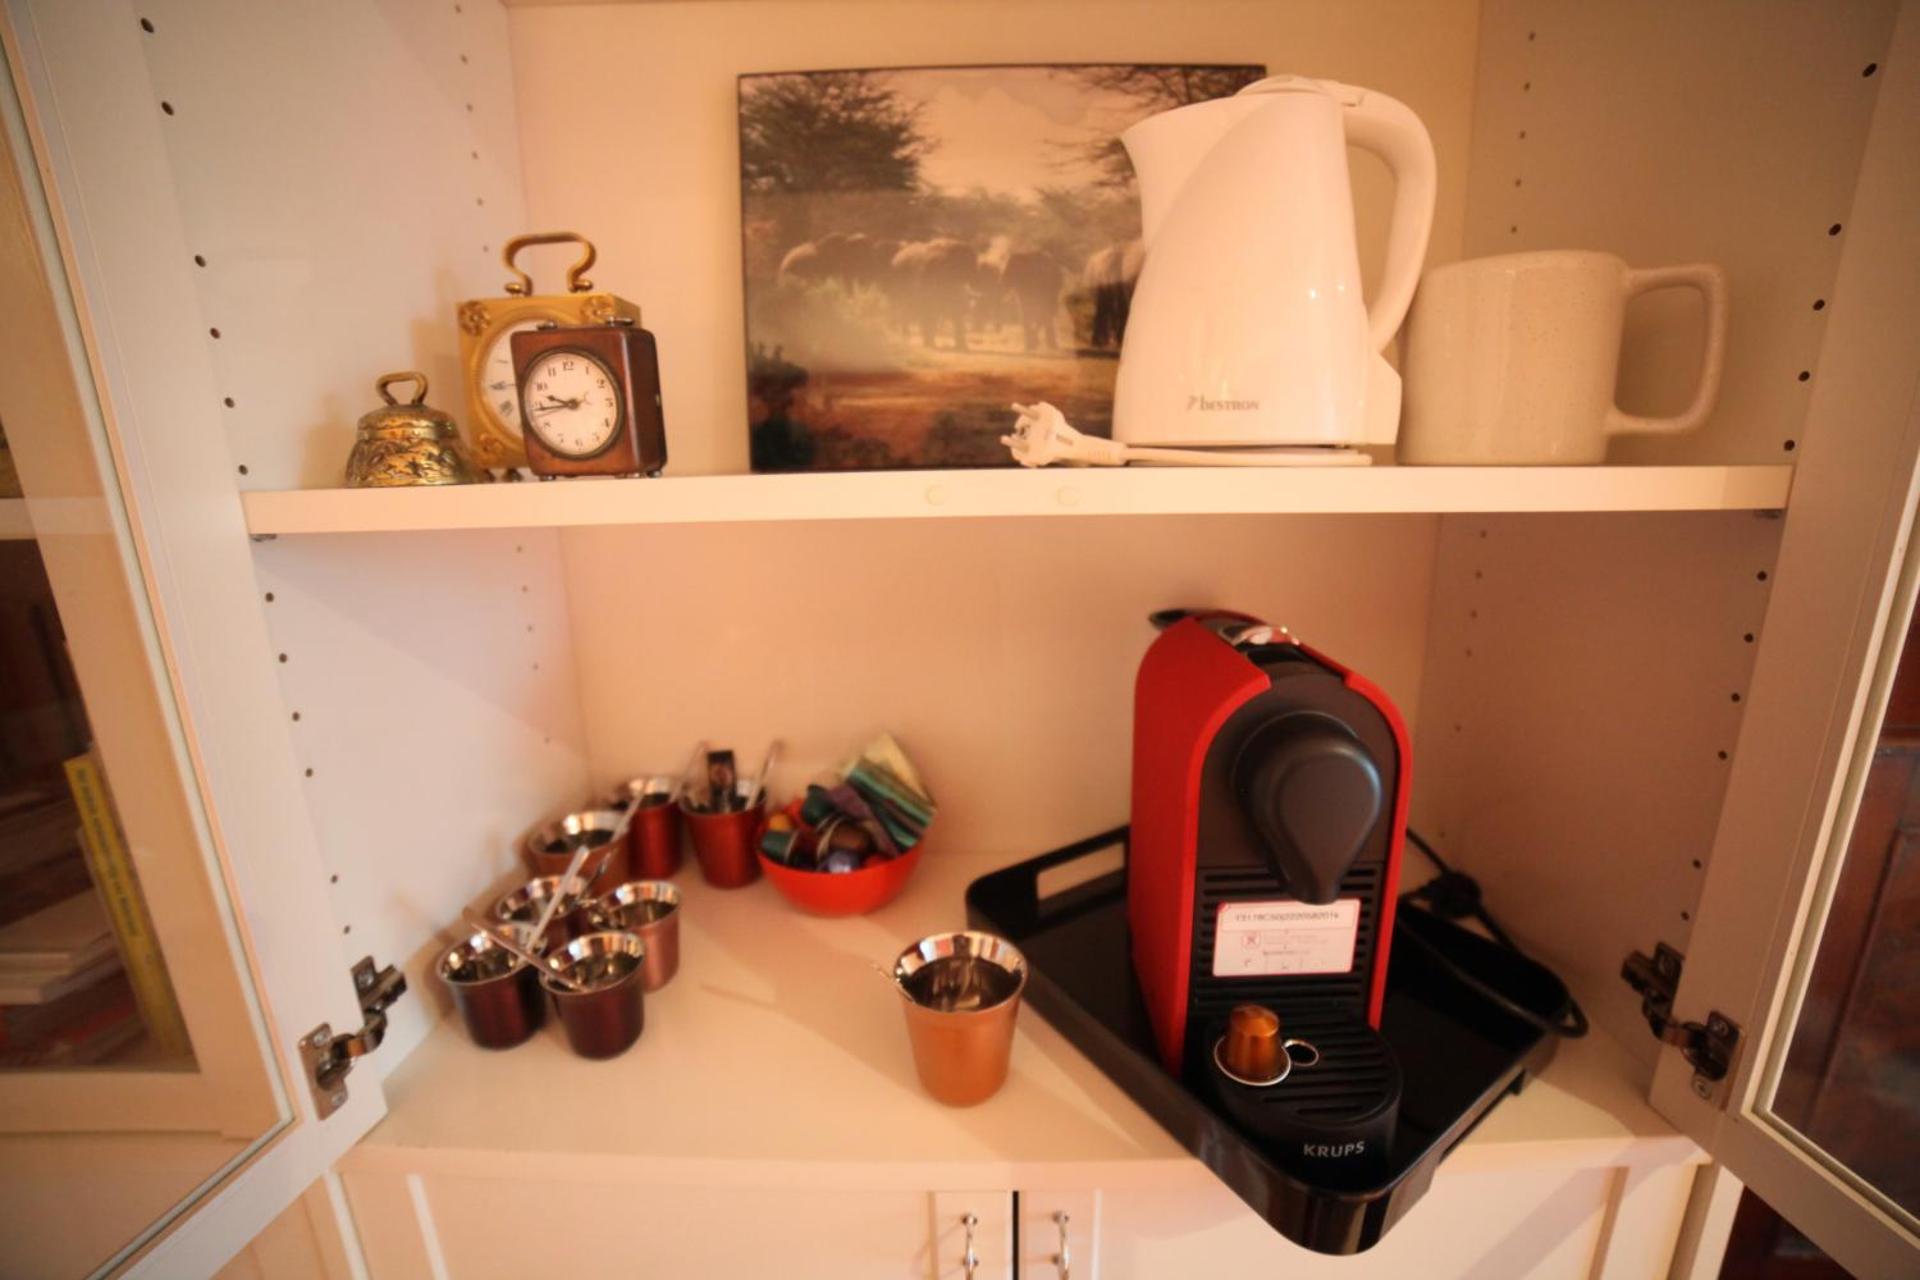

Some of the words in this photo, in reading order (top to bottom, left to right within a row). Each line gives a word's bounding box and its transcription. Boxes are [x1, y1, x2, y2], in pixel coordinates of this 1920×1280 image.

[562, 361, 575, 371] 12
[547, 367, 557, 377] 11
[1303, 1140, 1365, 1157] KRUPS
